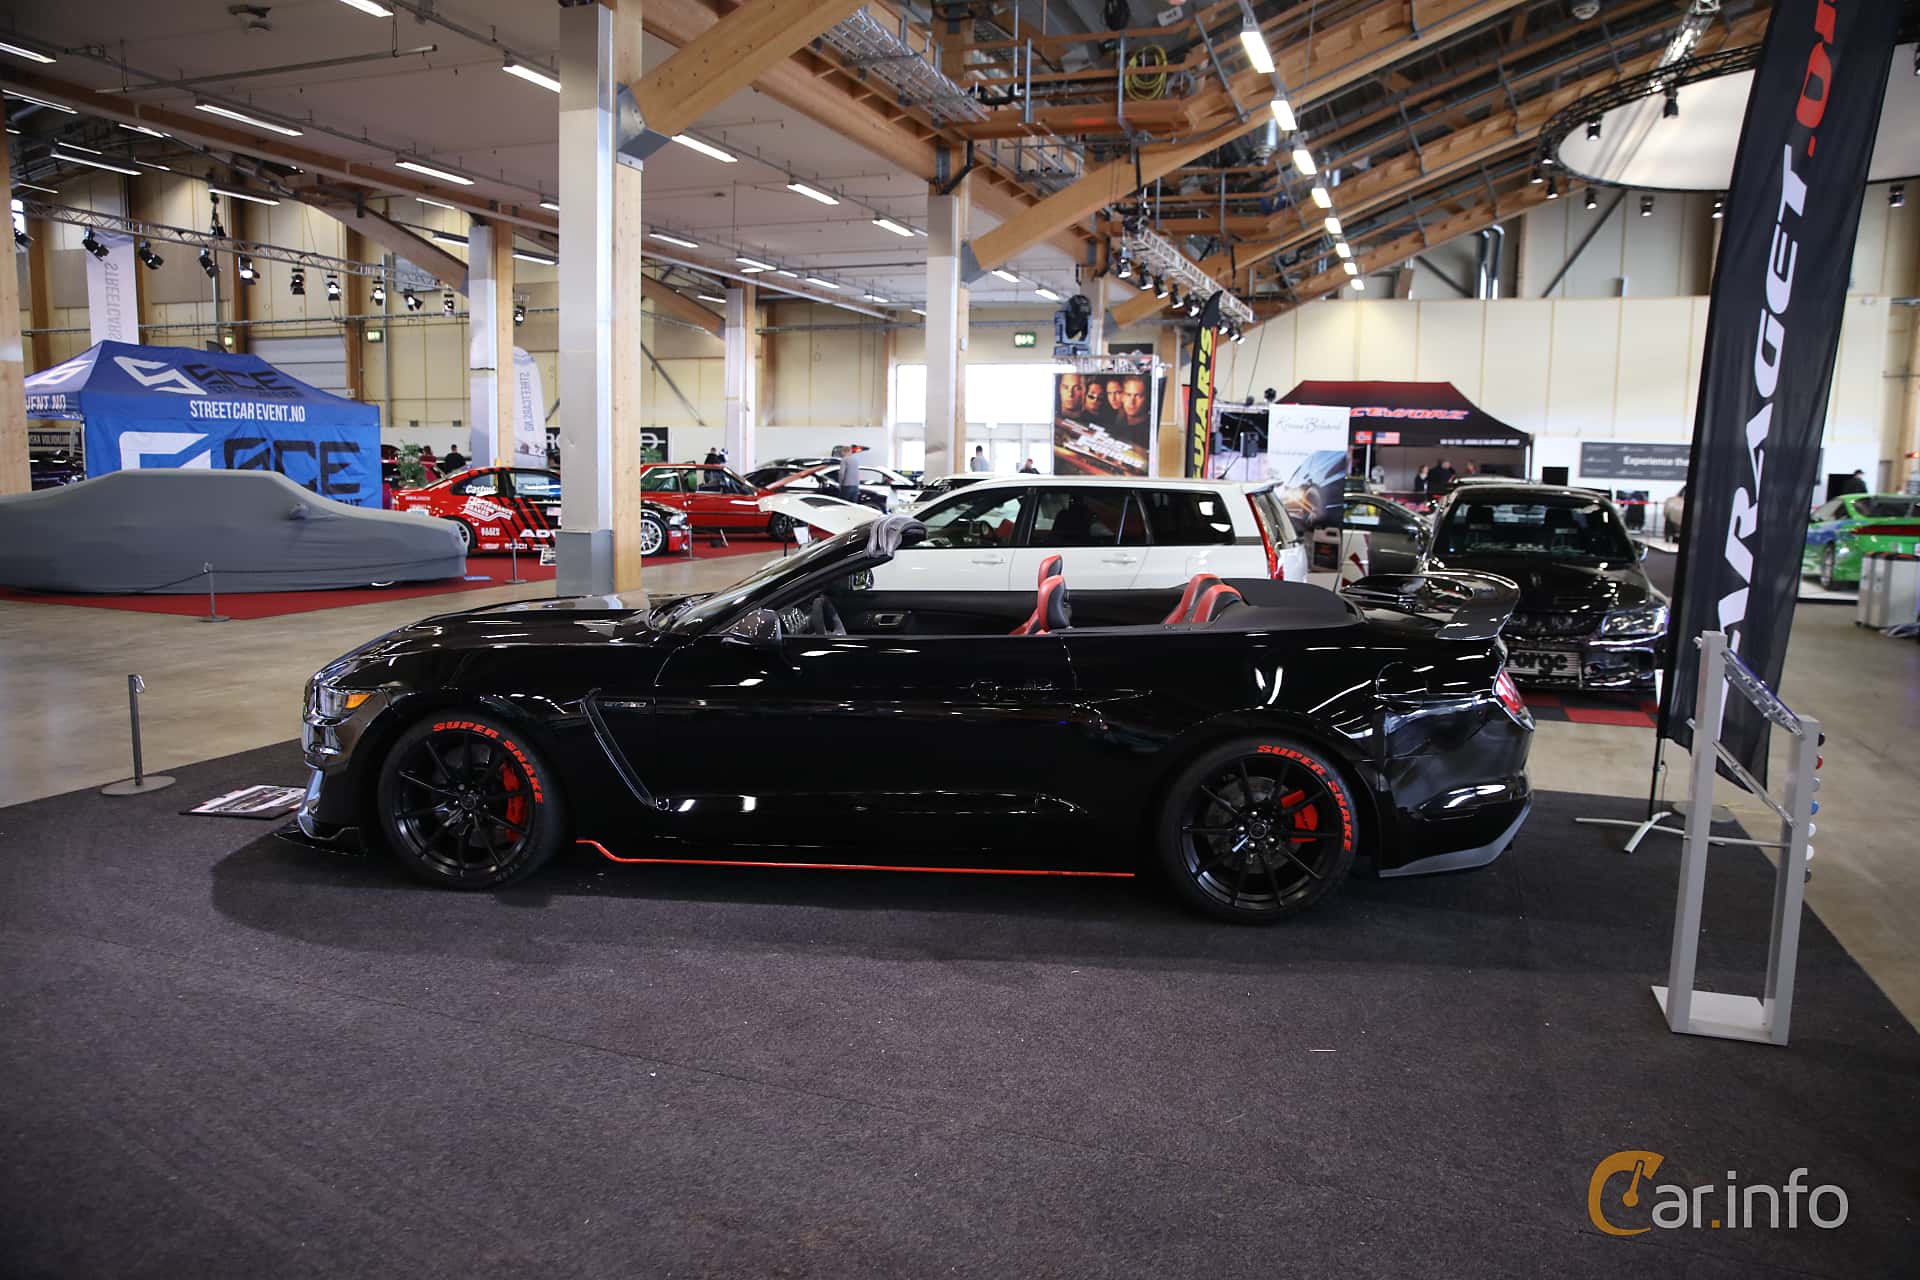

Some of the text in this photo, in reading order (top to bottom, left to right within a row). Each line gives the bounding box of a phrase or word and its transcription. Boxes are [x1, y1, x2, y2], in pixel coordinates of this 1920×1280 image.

[432, 720, 545, 805] SUPER SNAKE
[1256, 744, 1353, 853] SUPER SNAKE
